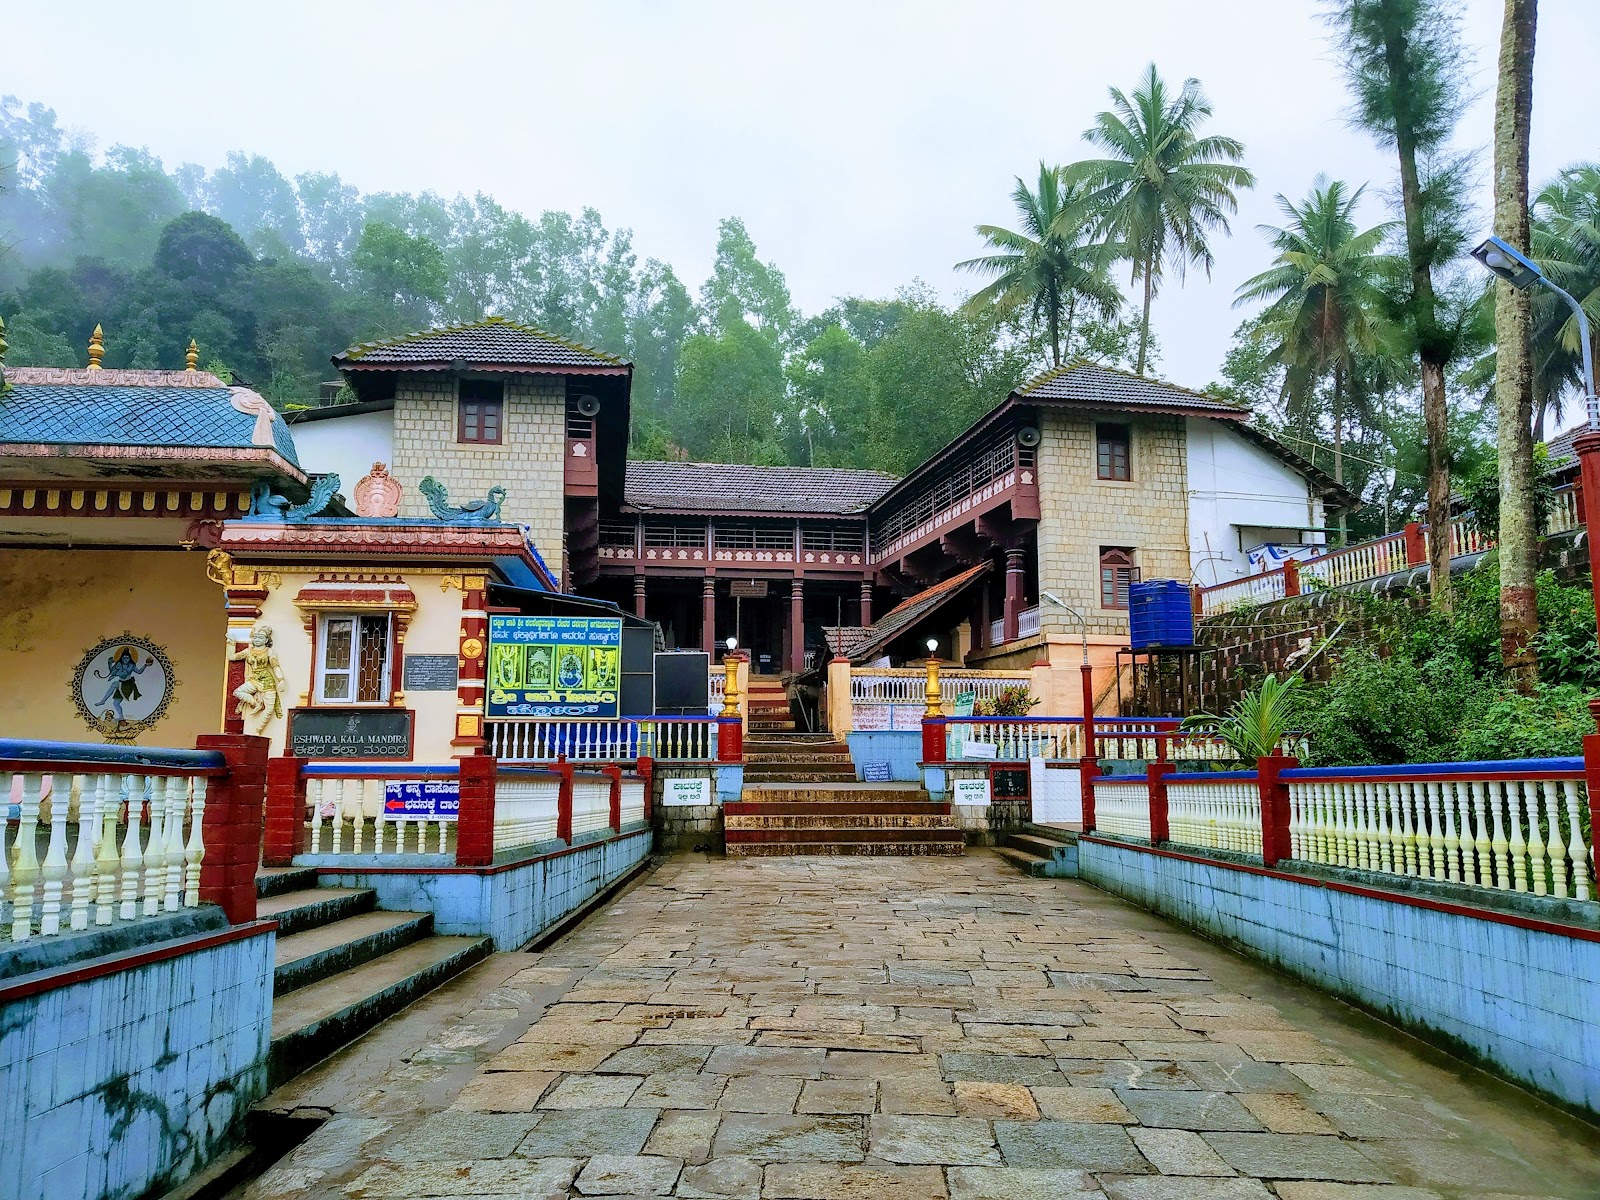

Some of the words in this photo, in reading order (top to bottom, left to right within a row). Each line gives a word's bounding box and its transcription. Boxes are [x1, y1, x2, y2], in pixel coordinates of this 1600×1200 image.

[491, 690, 517, 704] ಶ್ರೀ
[293, 735, 337, 744] ESHWARA
[340, 735, 364, 744] KALA
[367, 735, 407, 744] MANDIRA
[294, 744, 326, 755] ಈಶ್ವರ
[331, 745, 358, 755] ಕಲಾ
[364, 744, 406, 755] ಮಂದಿರ
[386, 784, 402, 798] ನಿತ್ಯ
[405, 784, 421, 797] ಅನ್ನ
[405, 798, 436, 814] ಭವನಕ್ಕೆ
